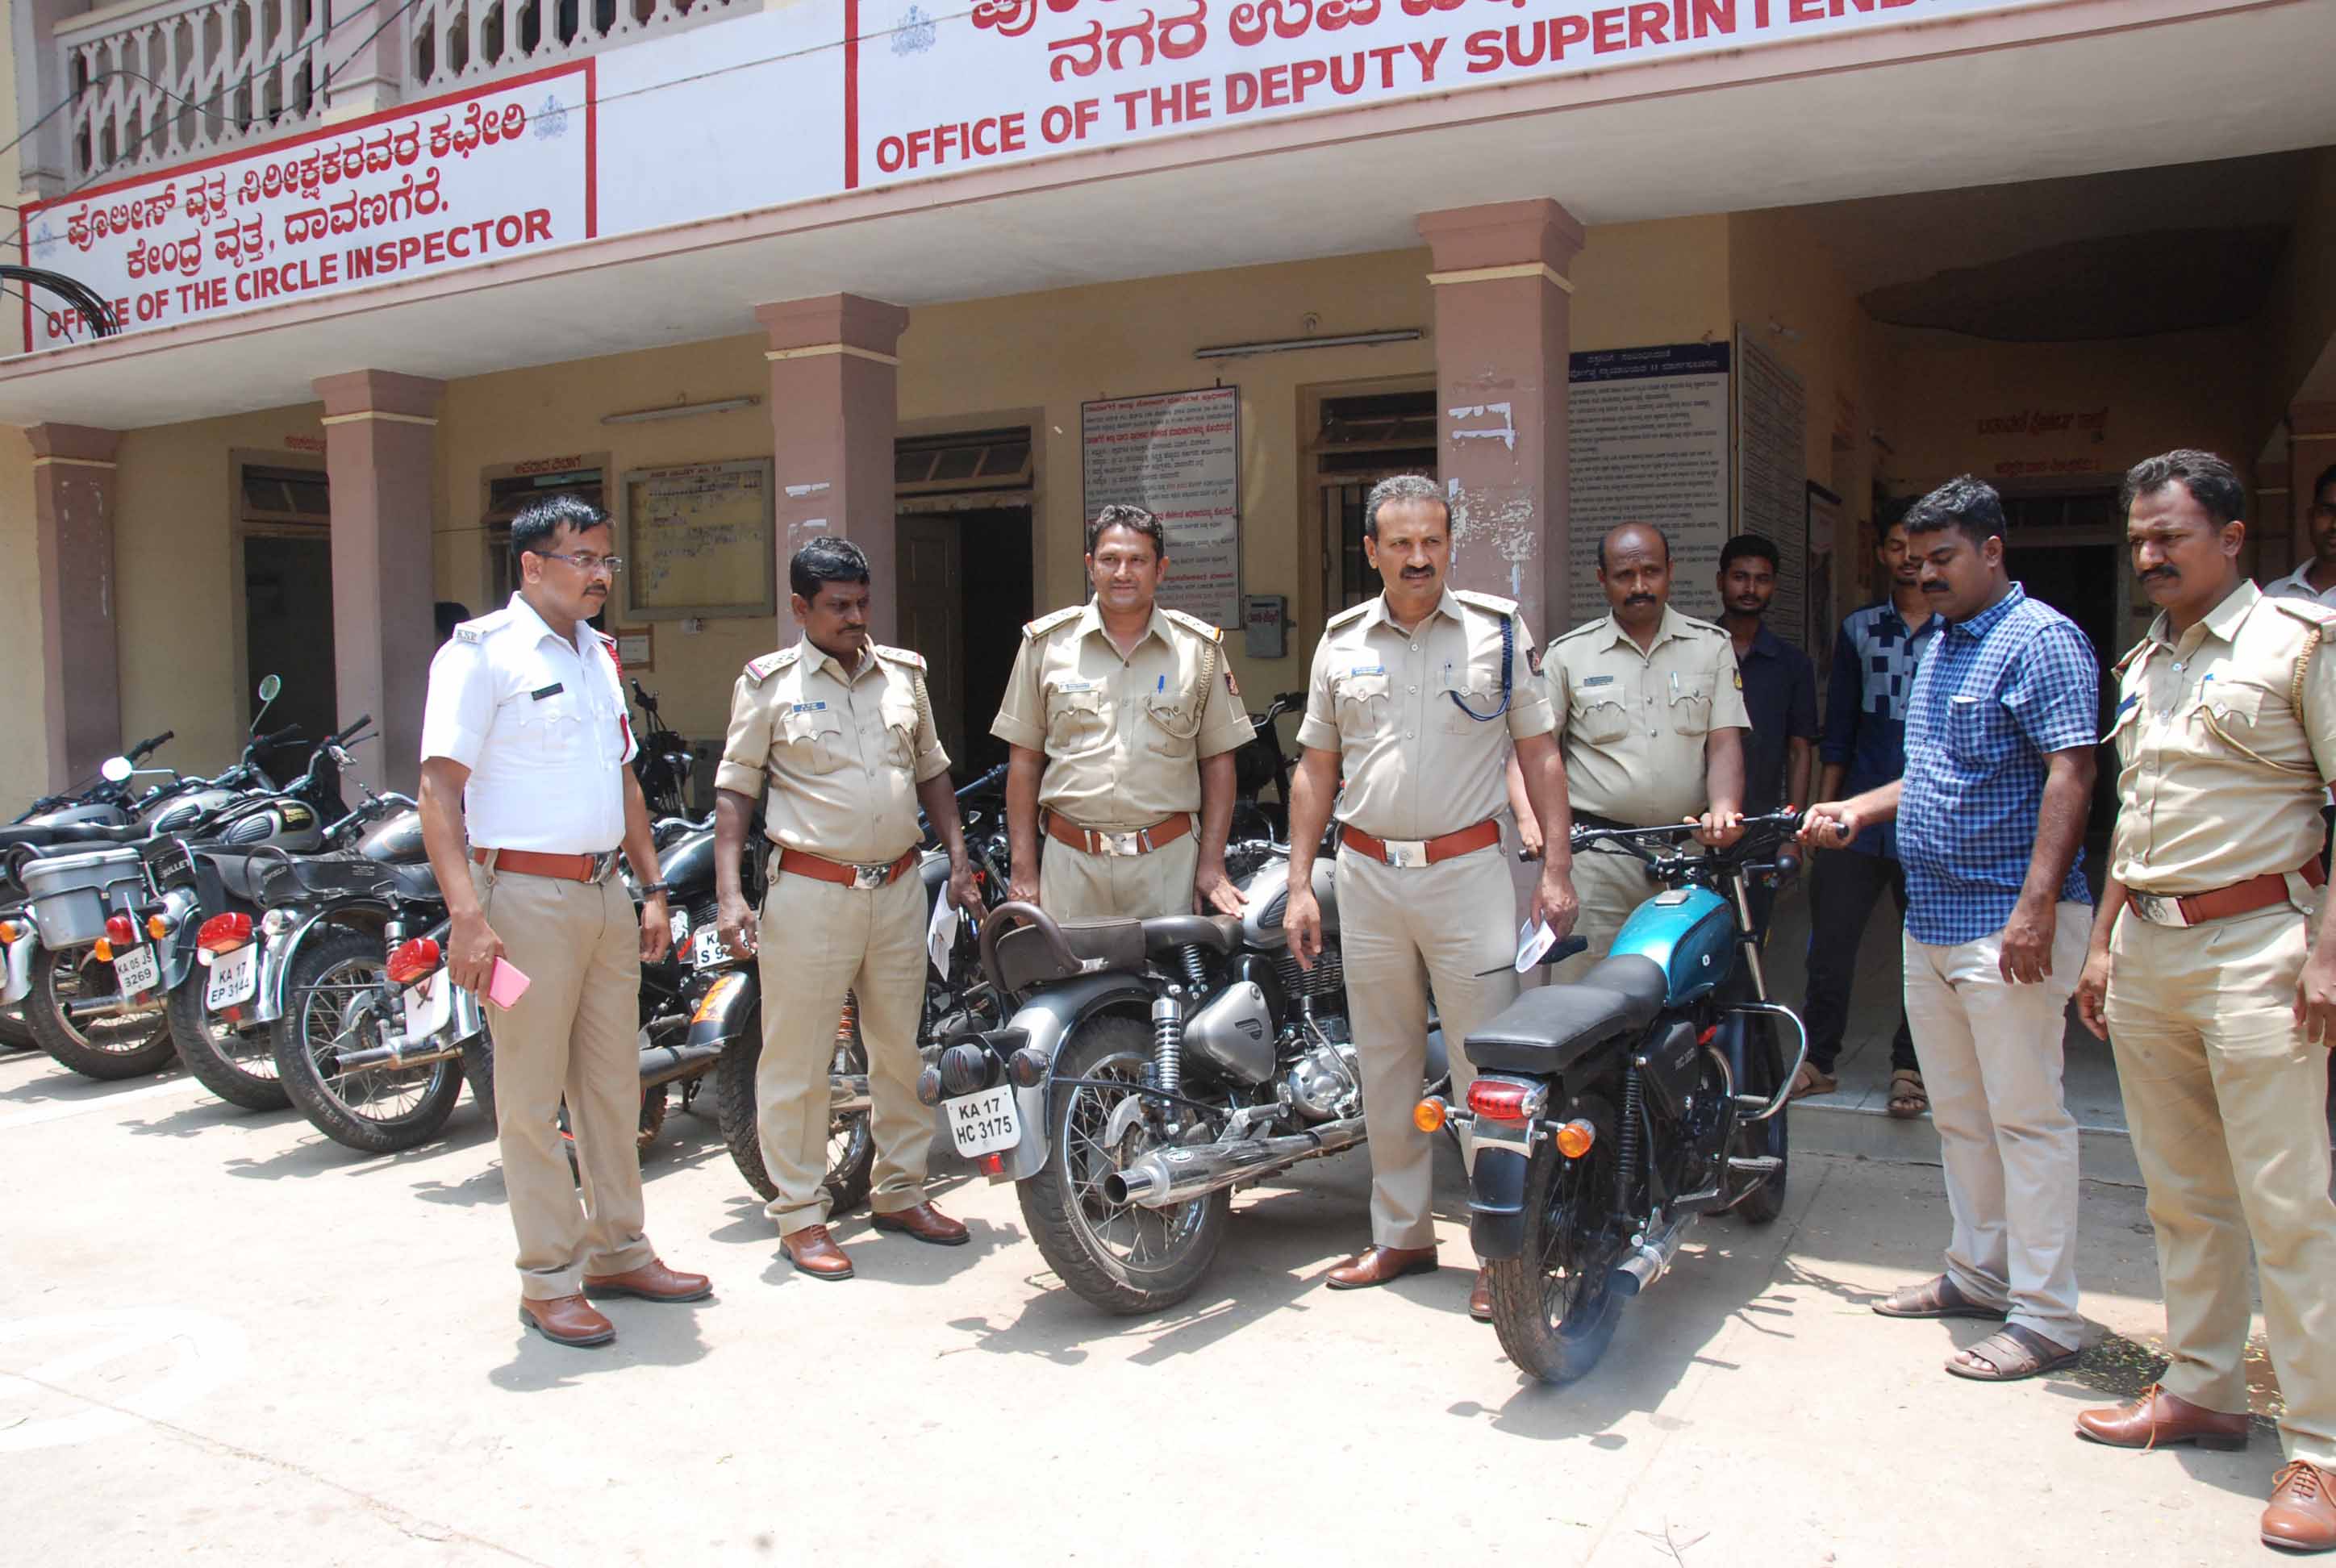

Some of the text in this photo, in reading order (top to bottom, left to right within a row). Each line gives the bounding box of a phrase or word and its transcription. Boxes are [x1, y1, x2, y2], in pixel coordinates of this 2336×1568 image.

[878, 0, 1916, 173] OFFICE OF THE DEPUTY SUPERIN
[186, 175, 228, 227] ವೃತ್ತ
[129, 232, 202, 278] ಕೇಂದ್ರ
[48, 209, 552, 339] OFFCE OF THE CIRCLE INSPECTOR
[118, 963, 129, 974] KA
[130, 958, 140, 970] 05
[701, 949, 710, 963] S
[124, 968, 152, 988] 3269
[219, 961, 247, 984] KA 17
[211, 987, 225, 1003] EP
[959, 1097, 999, 1120] KA 17
[956, 1116, 1012, 1145] HC 3175
